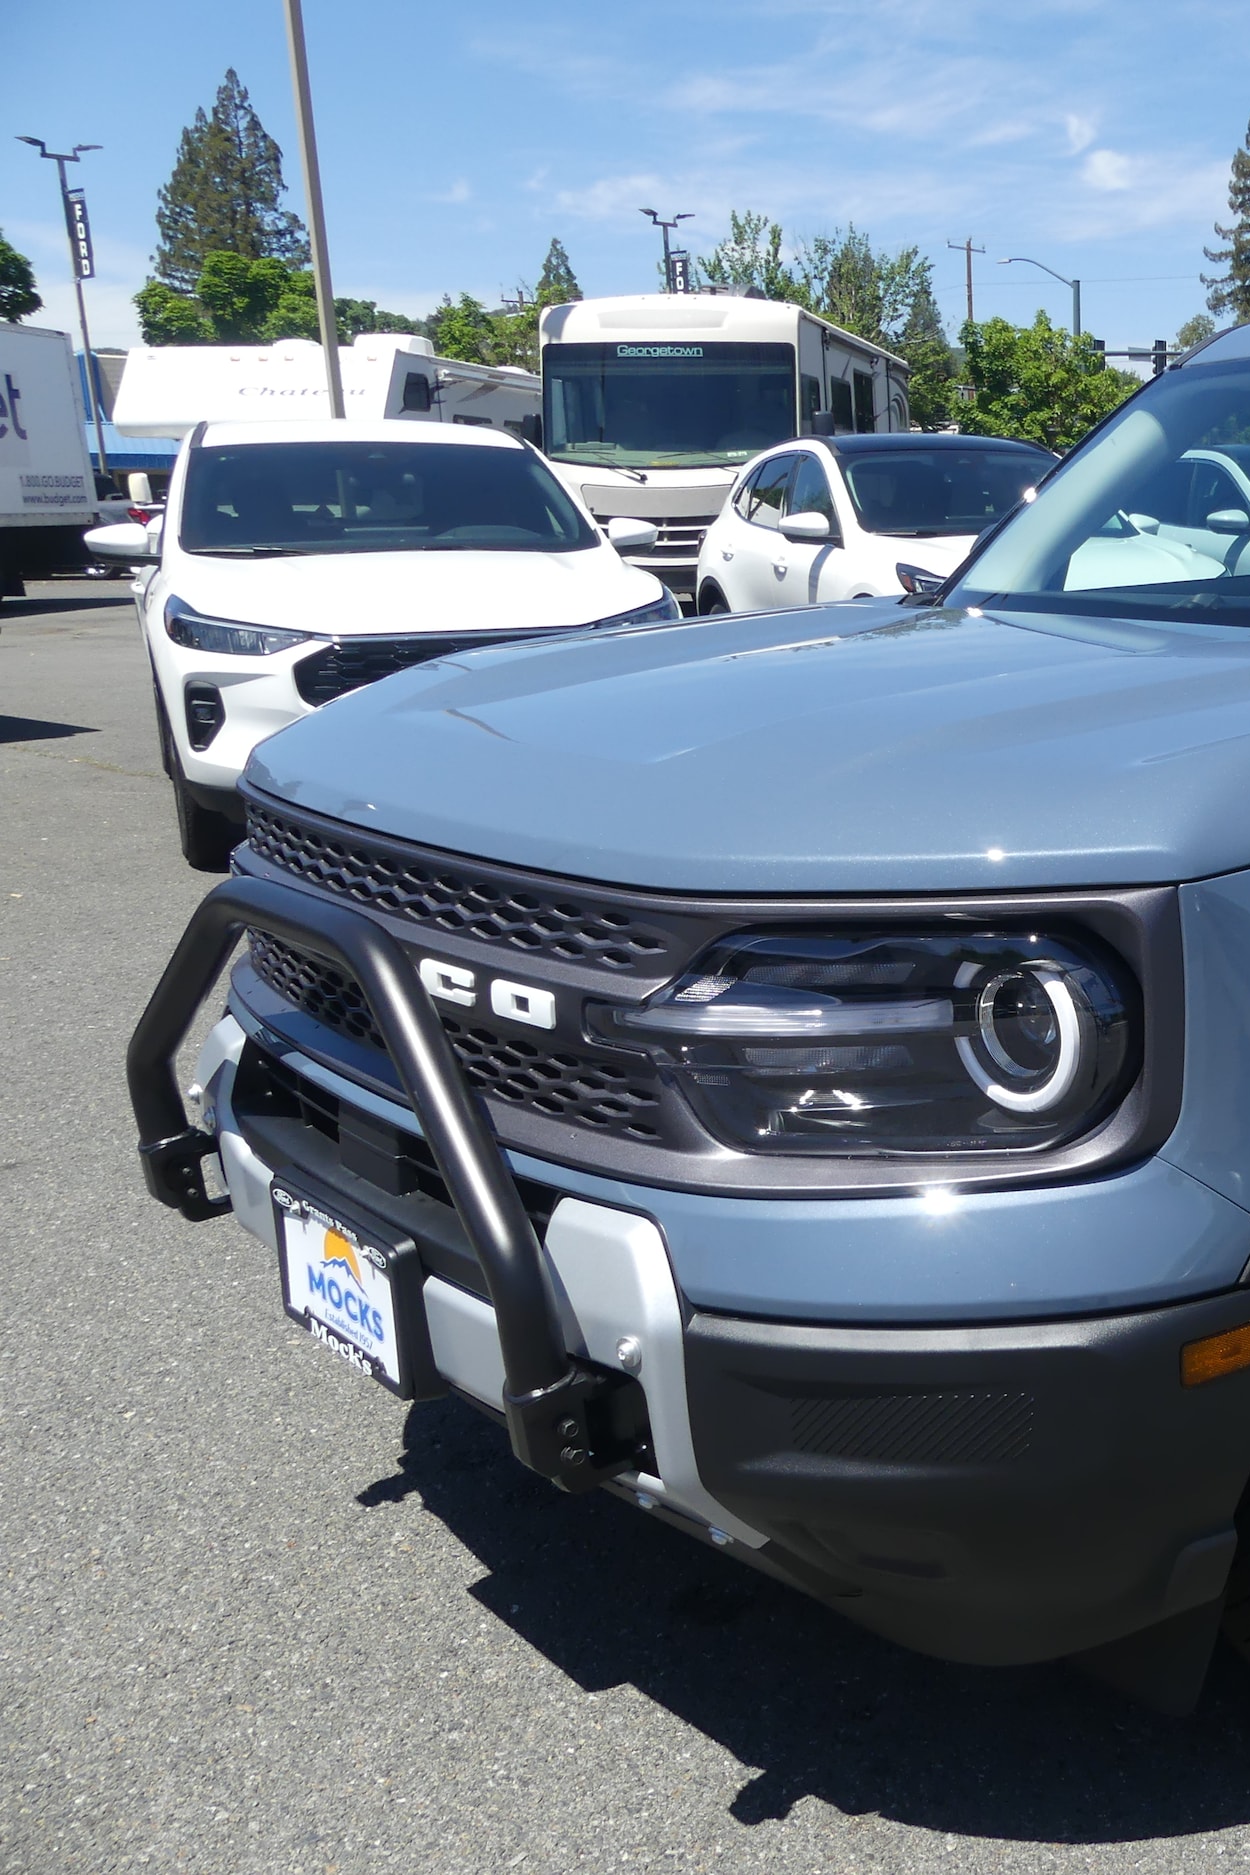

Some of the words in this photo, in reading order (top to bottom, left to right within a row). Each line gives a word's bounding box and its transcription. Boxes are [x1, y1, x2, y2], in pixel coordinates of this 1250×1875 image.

[74, 203, 91, 276] FORD
[675, 261, 685, 294] FO
[616, 344, 704, 357] Georgetown
[238, 386, 366, 396] Chateu
[22, 492, 88, 507] www.budget.com
[302, 1200, 334, 1227] Grants
[335, 1220, 358, 1242] Pass
[307, 1263, 384, 1342] MOCKS
[310, 1317, 373, 1376] Mock's
[325, 1308, 359, 1339] Established
[360, 1331, 373, 1351] 1957
